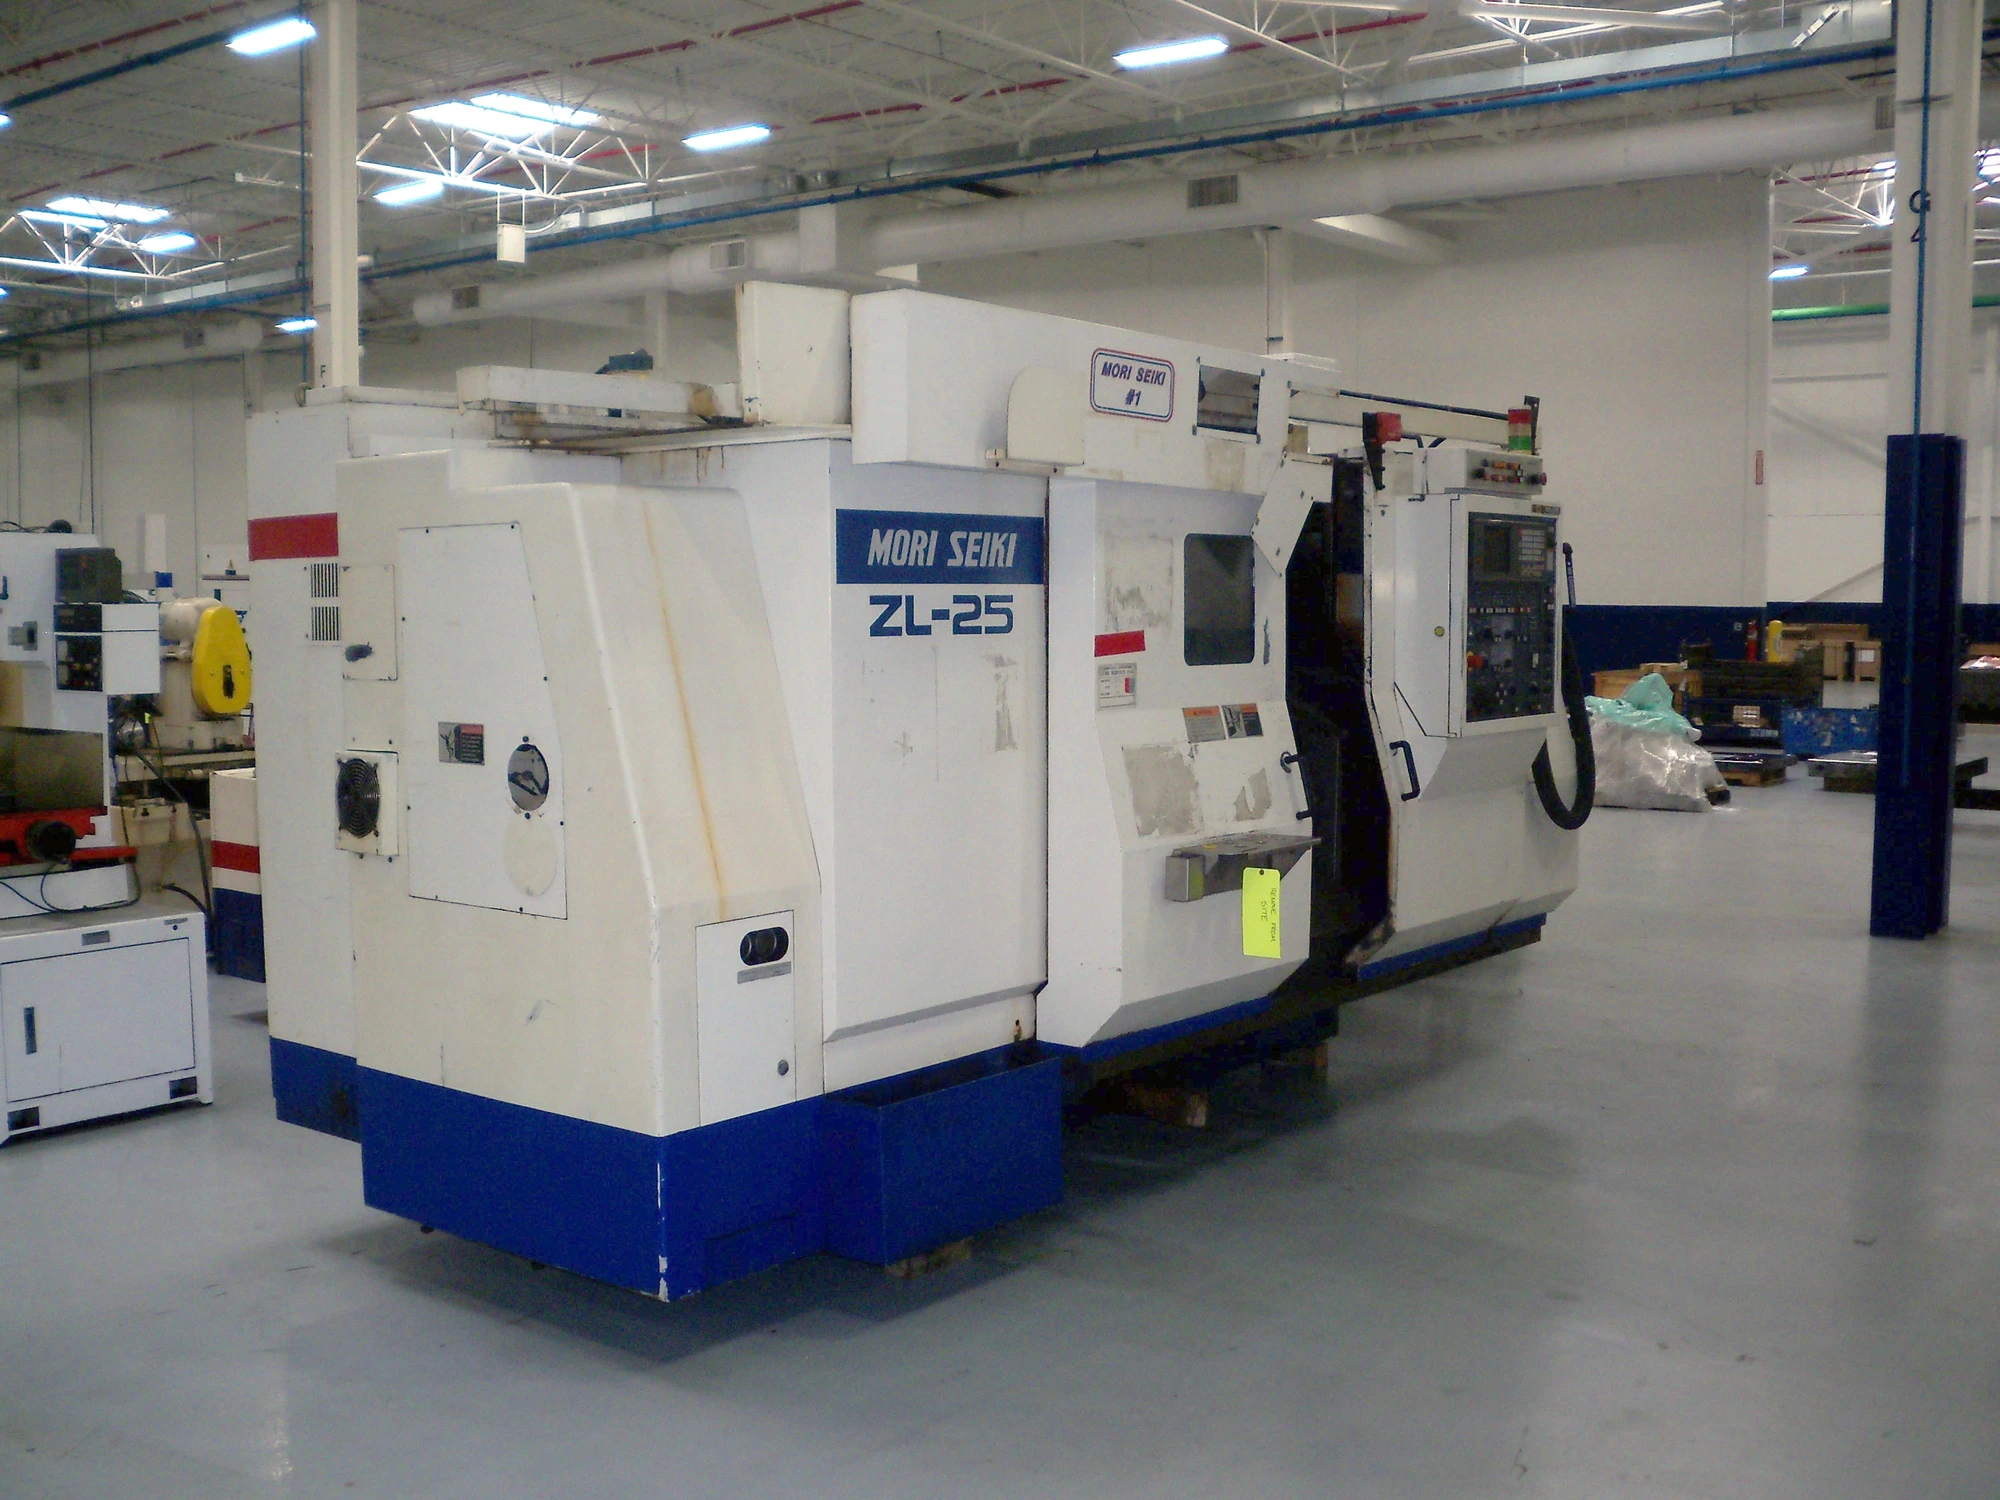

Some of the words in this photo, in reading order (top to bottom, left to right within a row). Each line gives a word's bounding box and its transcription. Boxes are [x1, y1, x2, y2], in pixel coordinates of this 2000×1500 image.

[1101, 361, 1133, 380] MORI
[1135, 367, 1167, 386] SEIKI
[1125, 388, 1142, 406] #1
[867, 528, 938, 567] MORI
[947, 530, 1017, 568] SEIKI
[869, 594, 1014, 637] ZL-25
[1260, 900, 1268, 922] SITE
